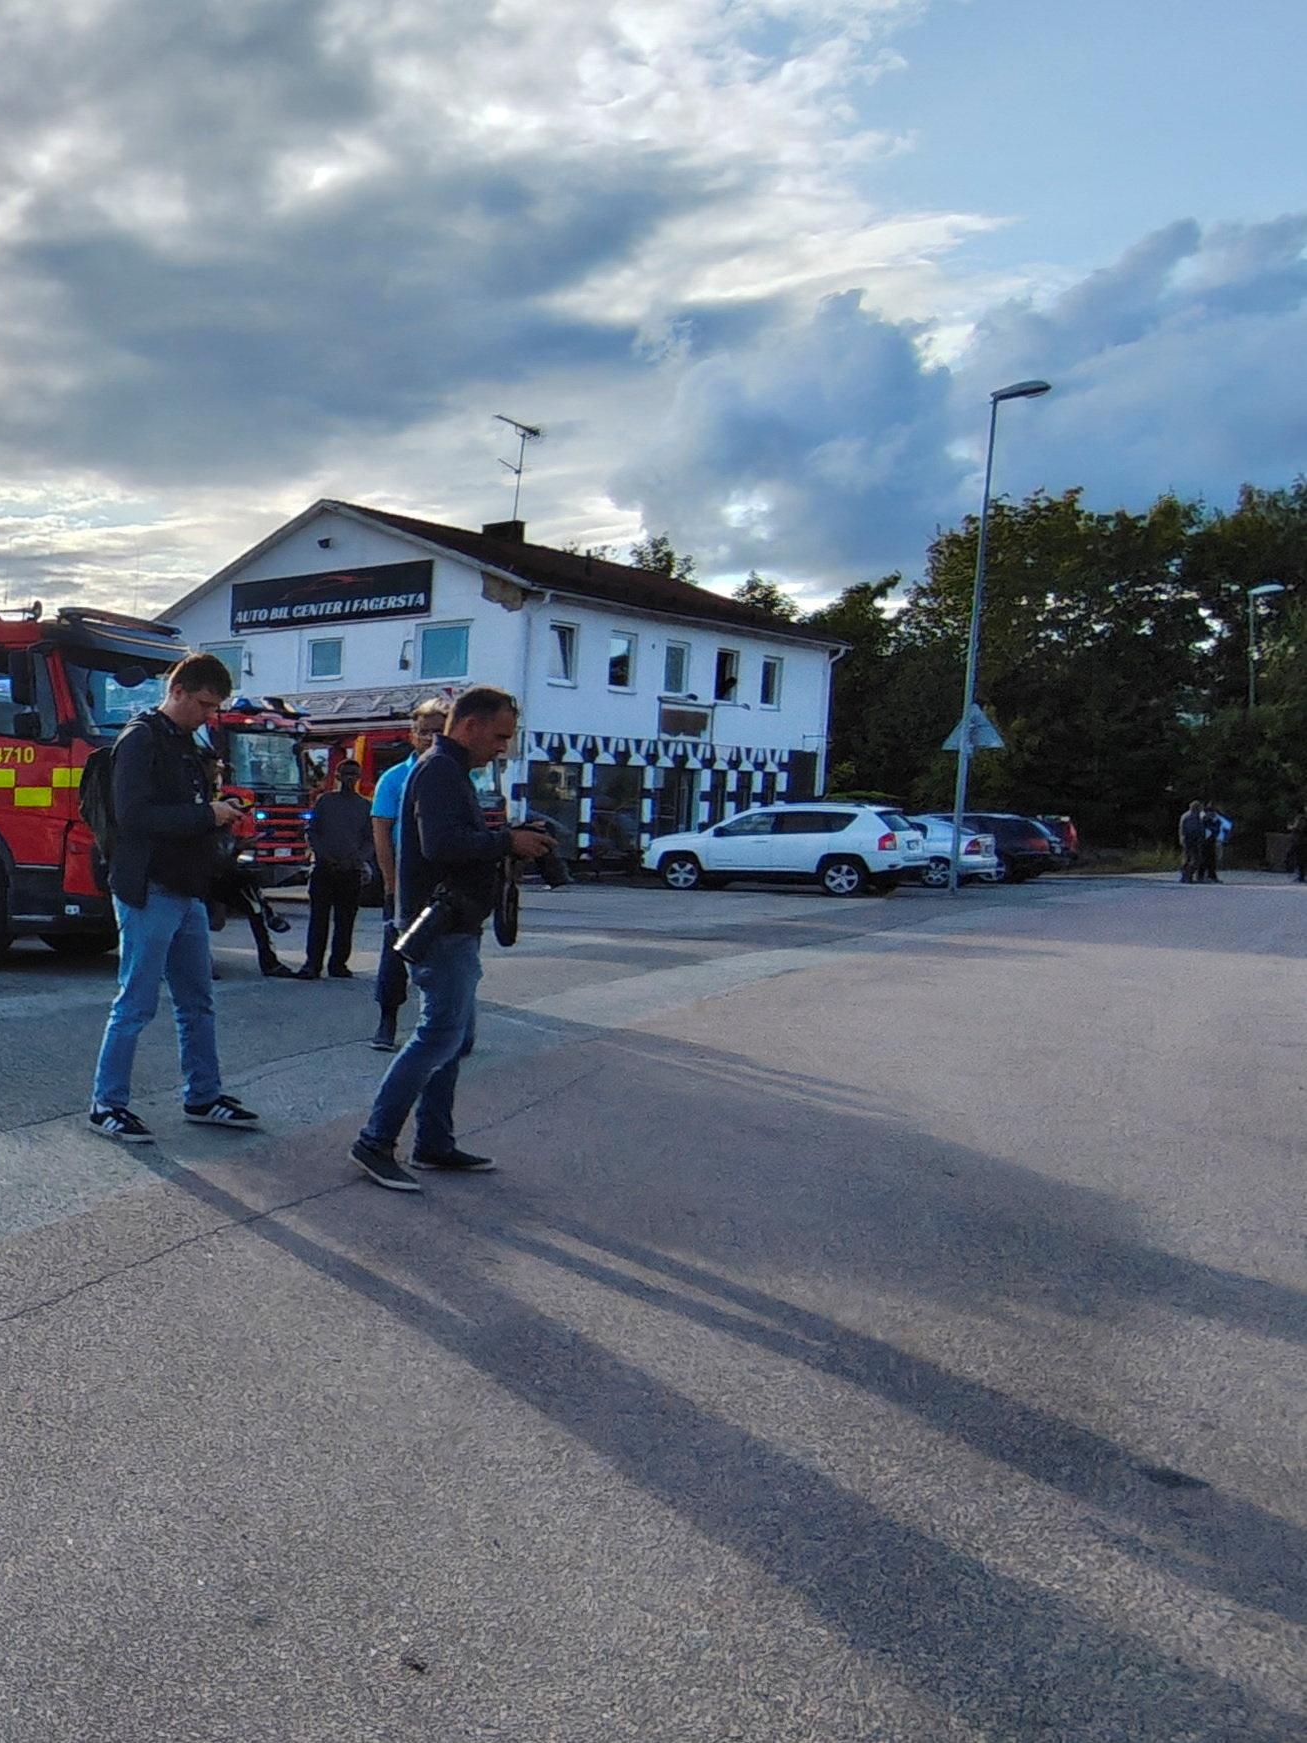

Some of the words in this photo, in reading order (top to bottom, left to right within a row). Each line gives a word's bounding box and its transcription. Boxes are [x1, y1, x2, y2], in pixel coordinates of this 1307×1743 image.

[234, 609, 269, 624] AUTO
[270, 606, 290, 620] BIL
[292, 601, 343, 618] CENTER
[344, 600, 351, 613] I
[352, 592, 425, 612] FAGERSTA
